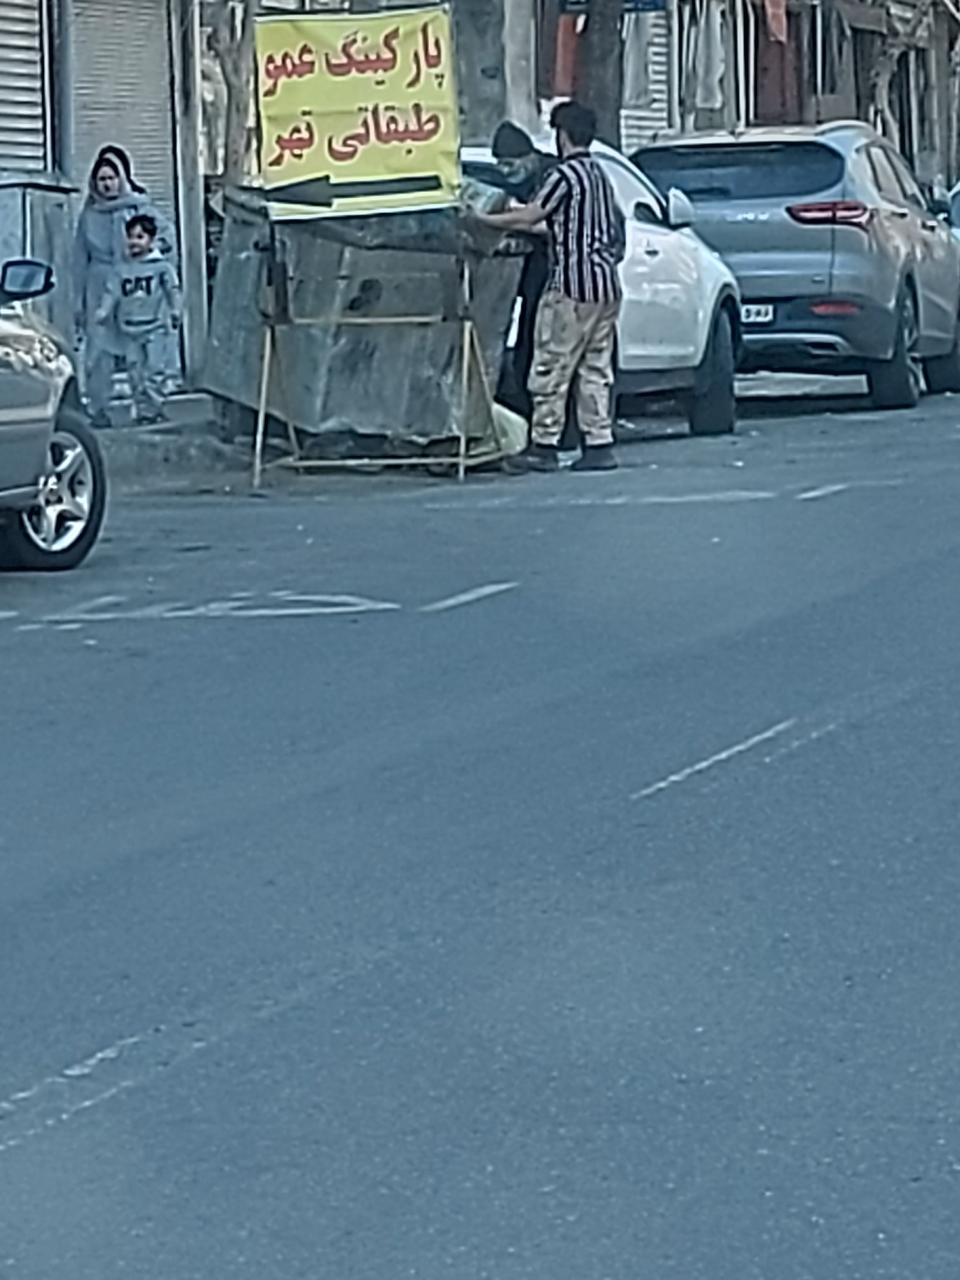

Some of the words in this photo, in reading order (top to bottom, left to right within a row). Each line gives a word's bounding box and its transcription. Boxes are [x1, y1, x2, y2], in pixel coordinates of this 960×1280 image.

[325, 22, 445, 89] پارکینگ
[327, 103, 441, 162] طبقاتی
[121, 275, 154, 298] CAT
